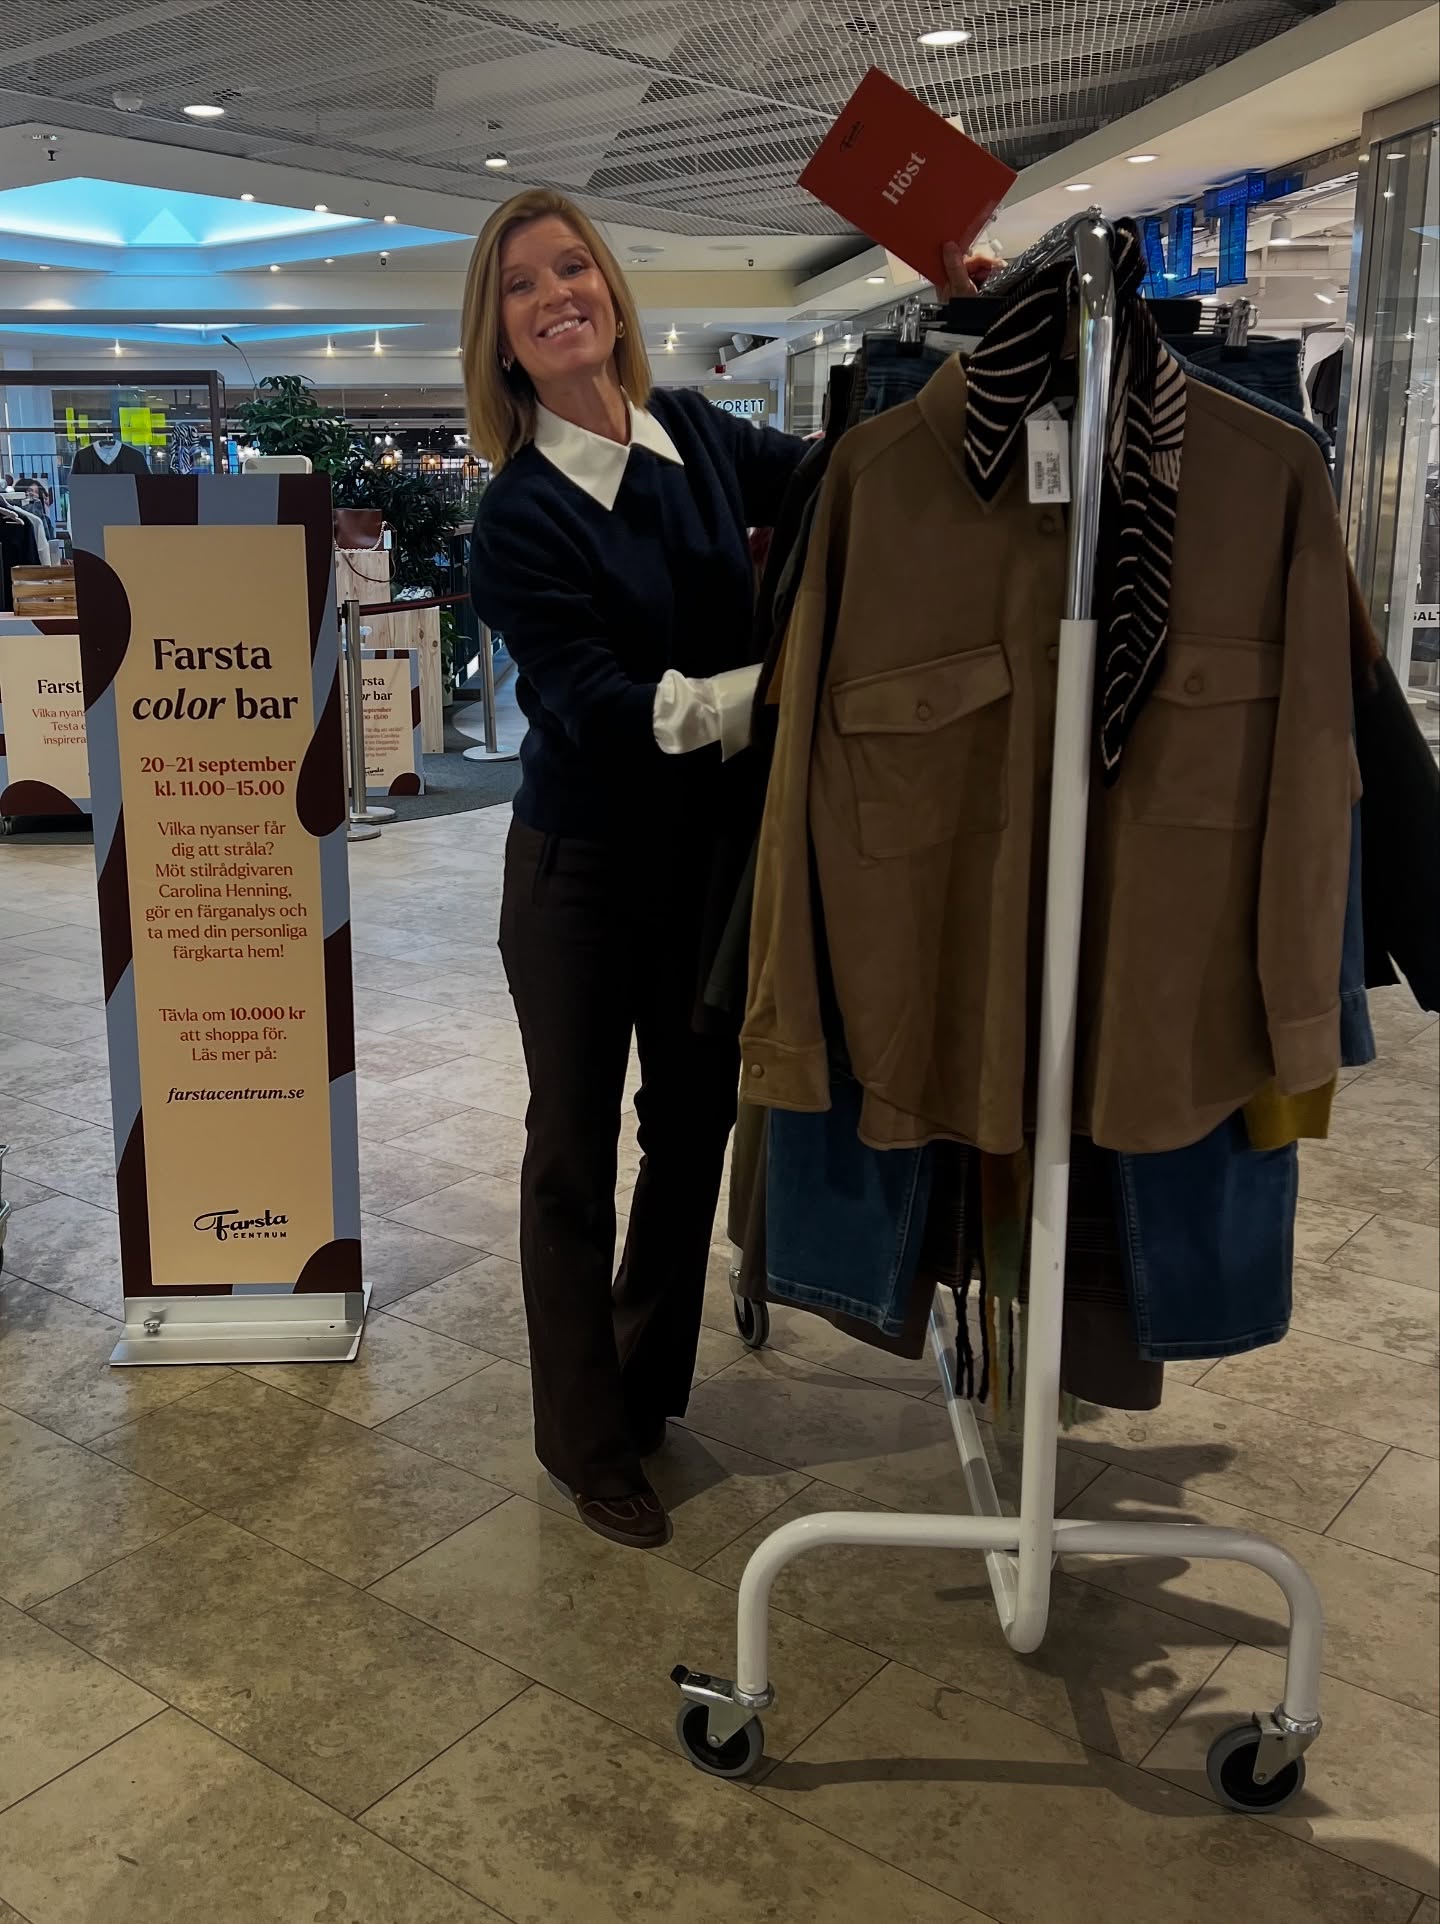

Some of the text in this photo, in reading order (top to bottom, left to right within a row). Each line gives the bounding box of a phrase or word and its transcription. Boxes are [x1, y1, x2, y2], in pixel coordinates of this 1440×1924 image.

[882, 151, 927, 206] Höst
[153, 639, 272, 670] Farsta
[37, 679, 83, 694] Farst
[132, 688, 299, 720] color bar
[373, 691, 393, 701] bar
[32, 708, 84, 719] Vilka nyan
[50, 721, 79, 731] Testa
[140, 756, 297, 776] 20–21 september
[154, 780, 176, 797] kl.
[157, 821, 287, 839] Vilka nyanser får
[171, 841, 275, 859] dig att stråla?
[155, 862, 293, 880] Möt stilrådgivaren
[158, 884, 222, 898] Carolina
[145, 903, 308, 922] gör en färganalys och
[147, 924, 308, 942] ta med din personliga
[173, 944, 285, 962] färgkarta hem!
[158, 1006, 306, 1022] Tävla om 10.000 kr
[179, 1027, 287, 1043] att shoppa för.
[192, 1046, 277, 1063] Läs mer på:
[166, 1087, 305, 1104] farstacentrum.se
[194, 1209, 288, 1241] Farsta
